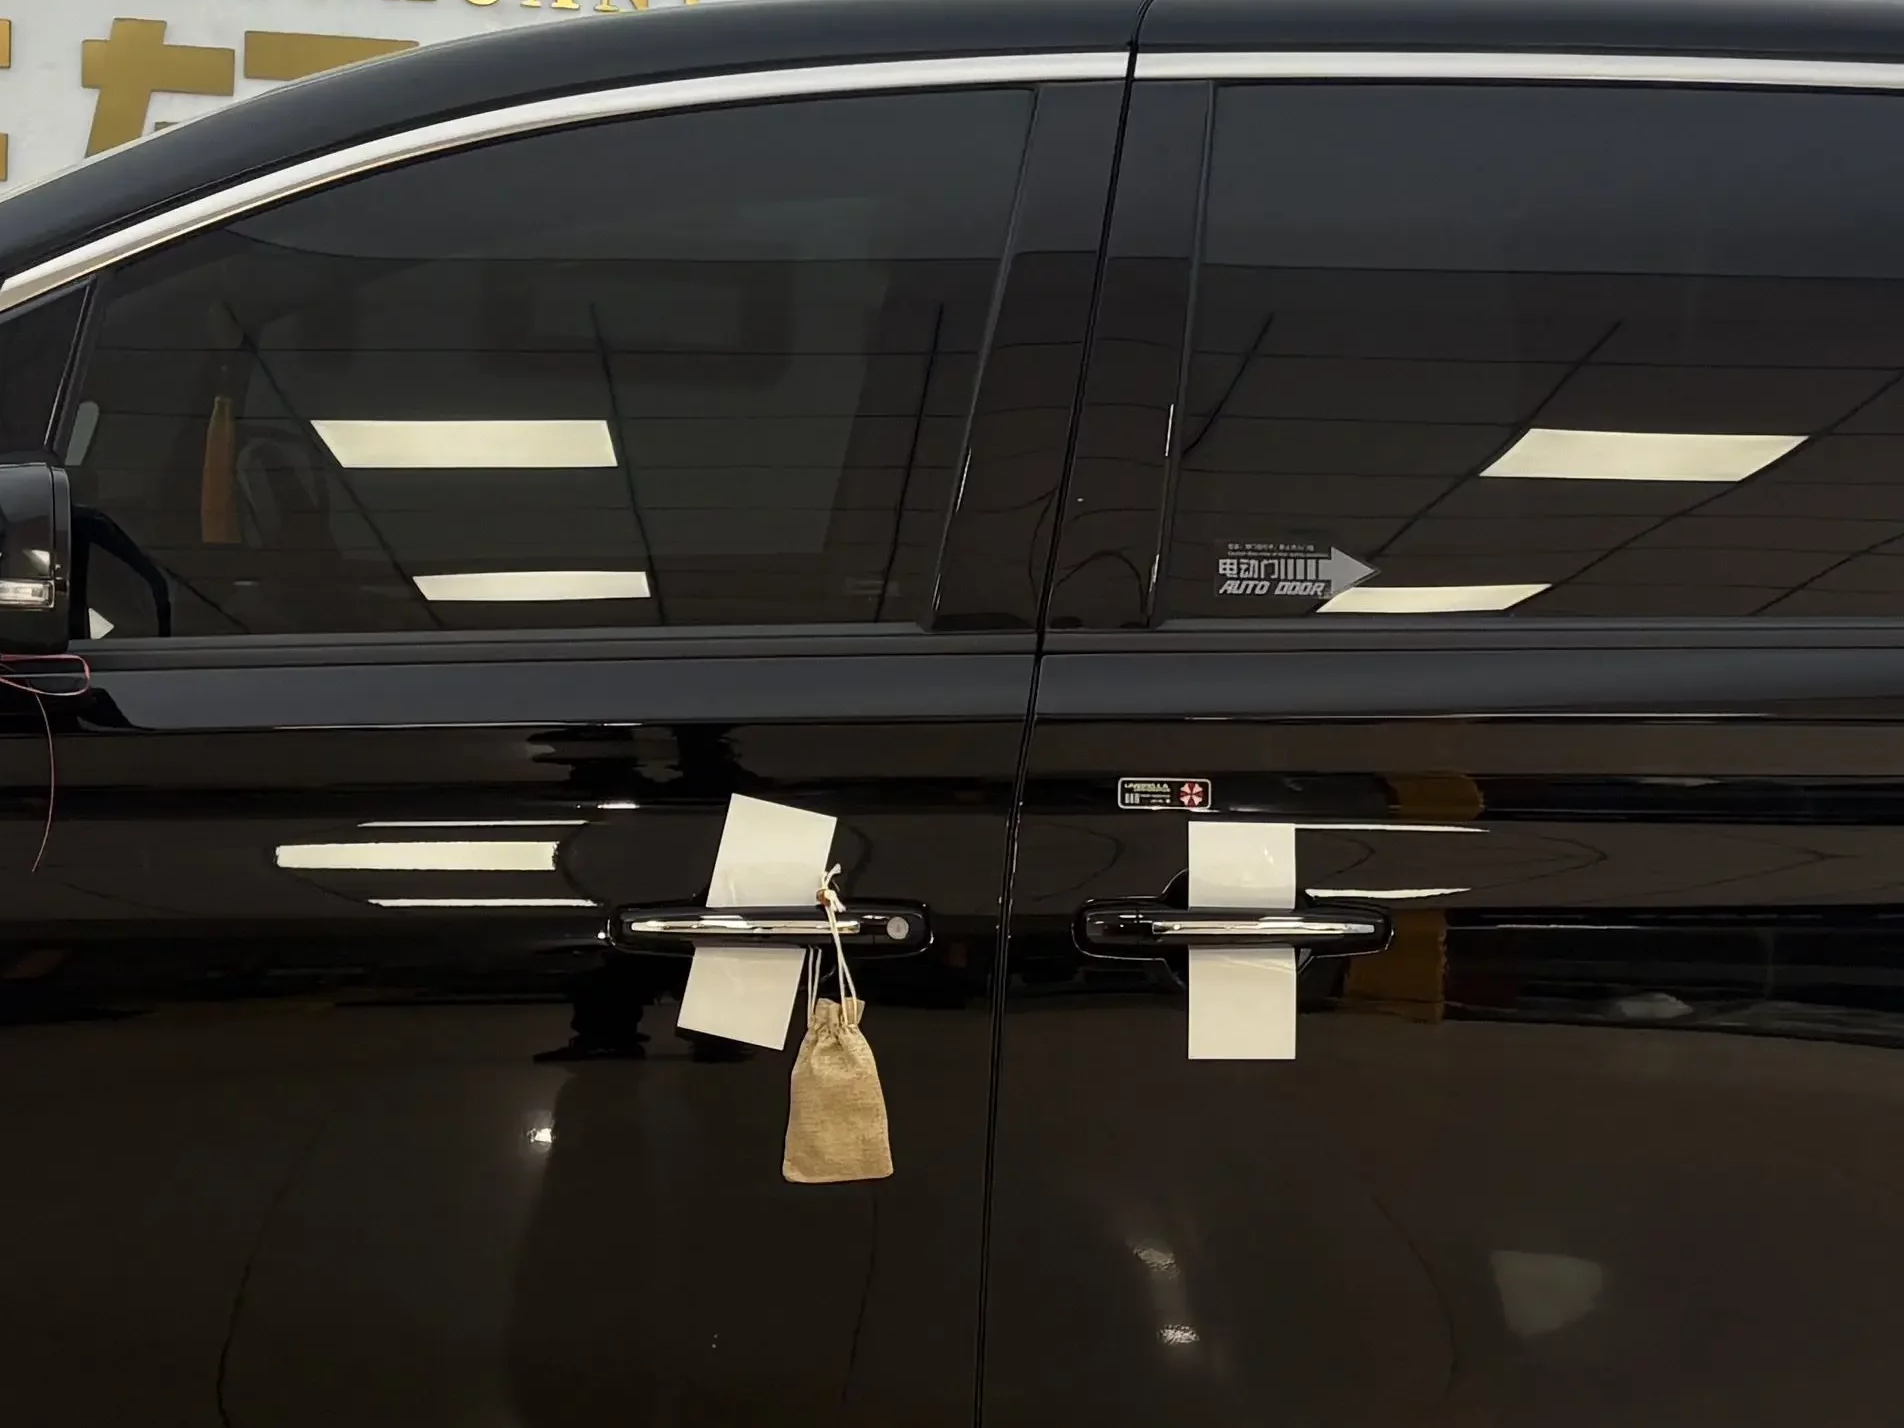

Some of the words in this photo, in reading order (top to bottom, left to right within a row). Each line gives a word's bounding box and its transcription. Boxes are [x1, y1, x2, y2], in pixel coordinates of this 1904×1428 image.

[1218, 558, 1279, 579] 电动门
[1219, 580, 1271, 595] AUTO
[1274, 581, 1326, 596] DOOR
